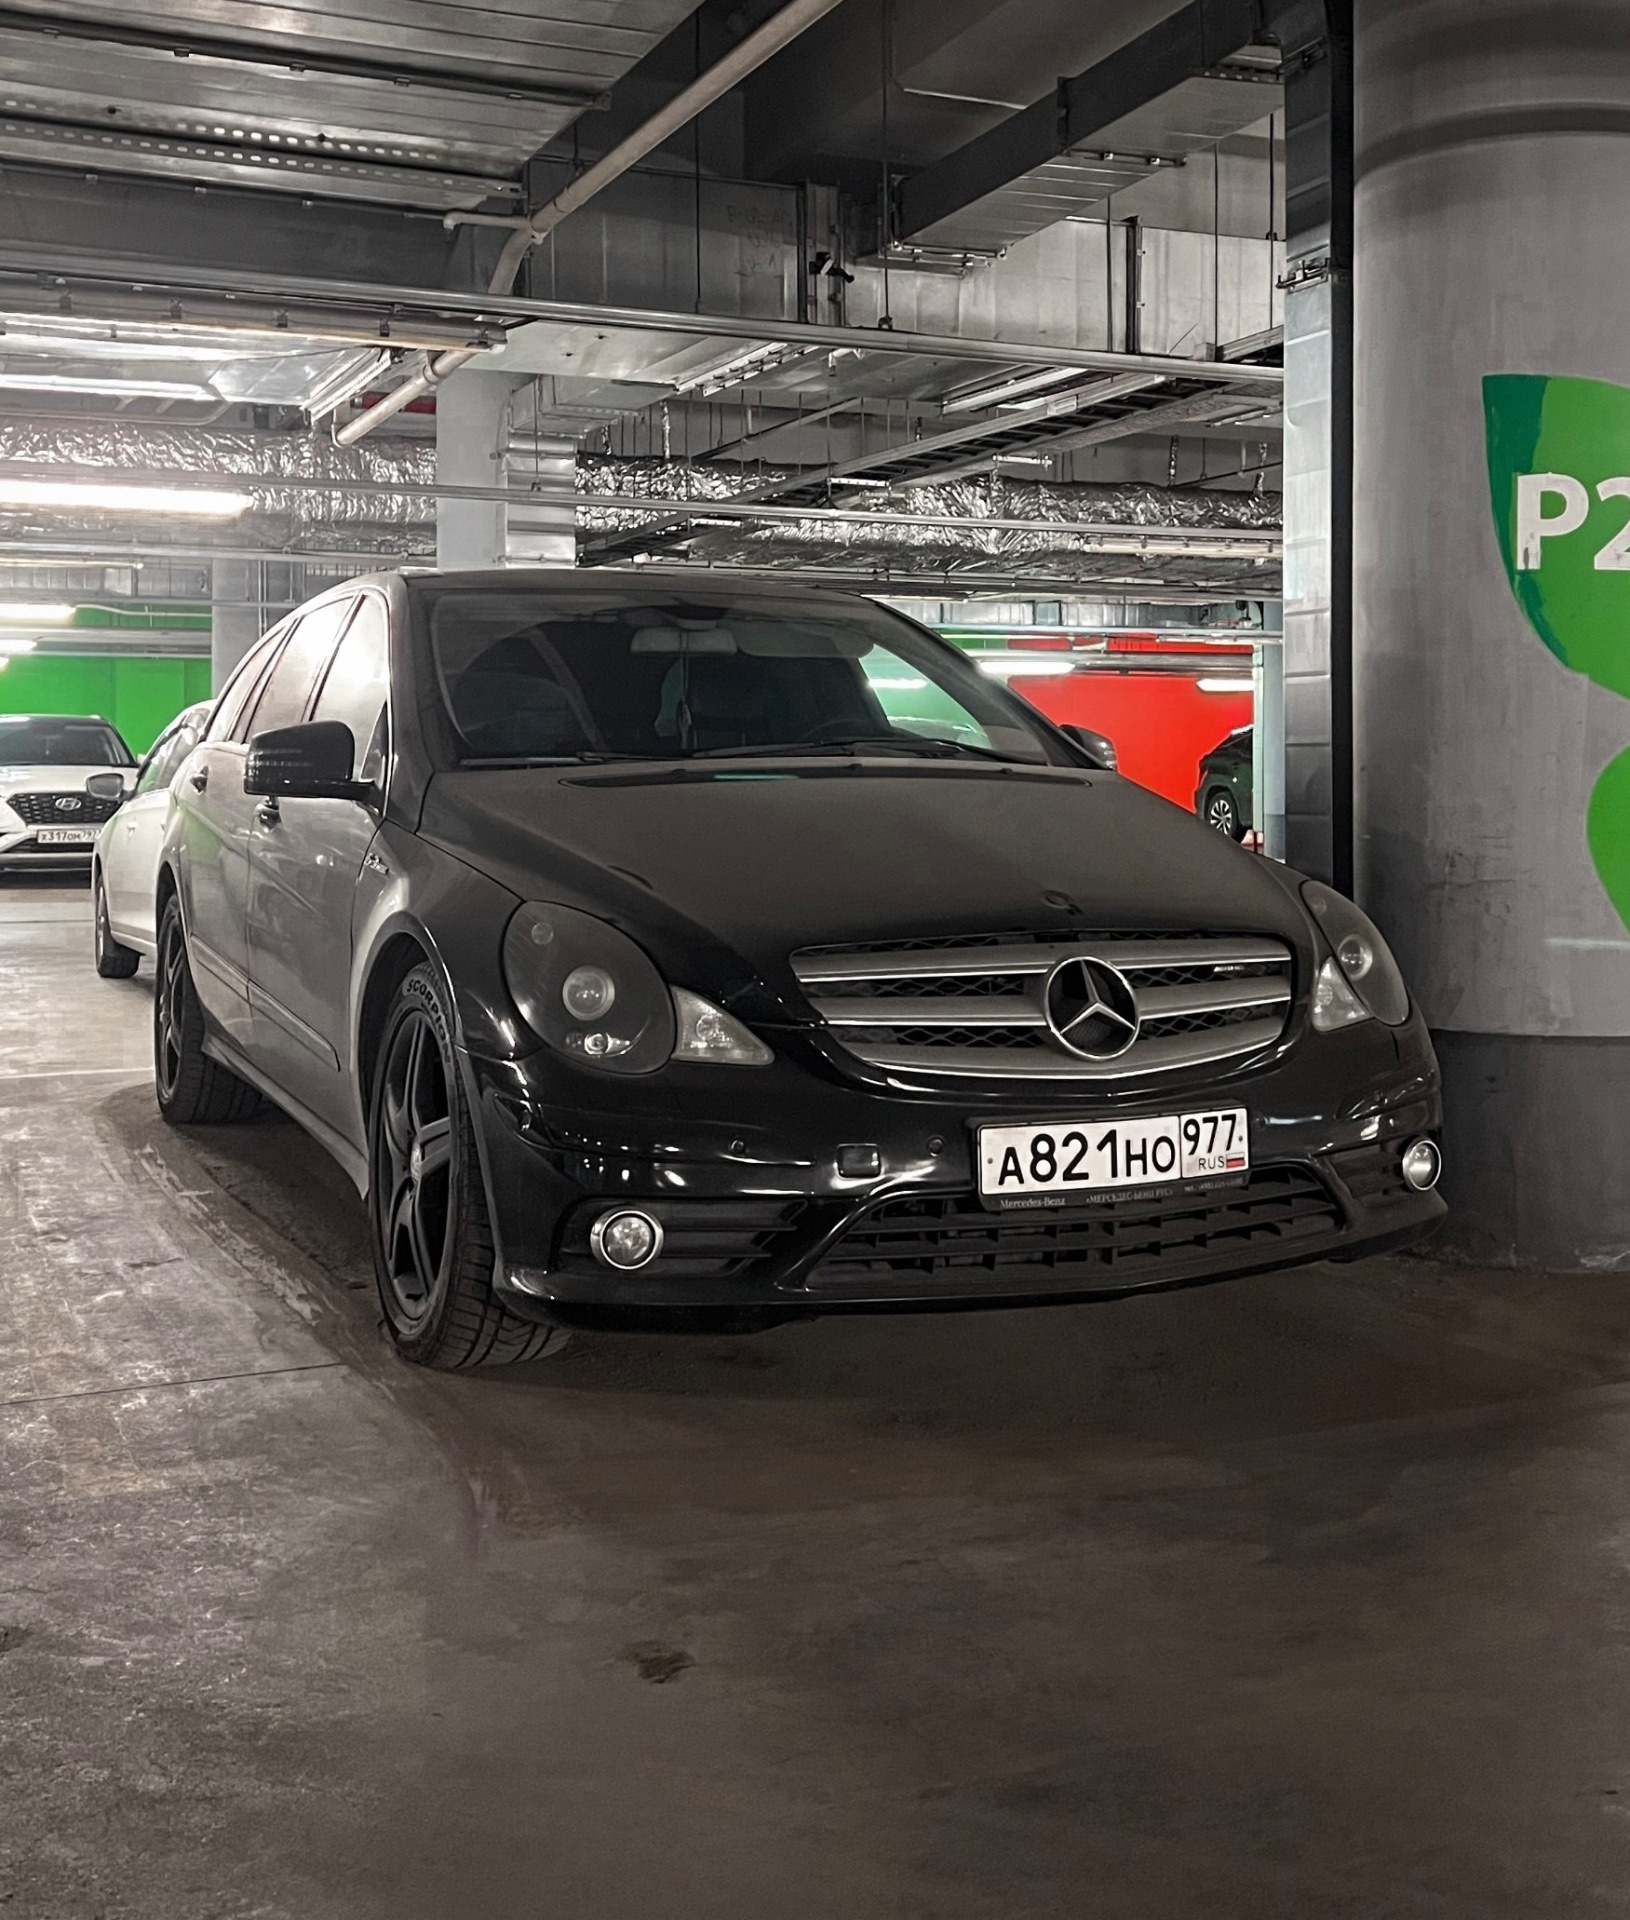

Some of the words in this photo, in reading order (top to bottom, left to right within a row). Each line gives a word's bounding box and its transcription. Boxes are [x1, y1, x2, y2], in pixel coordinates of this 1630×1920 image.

[1517, 472, 1630, 571] P2
[407, 980, 451, 1064] SCORPION
[1183, 1113, 1237, 1156] 977
[1198, 1156, 1225, 1171] RUS
[1000, 1197, 1066, 1209] Mercedes-Benz
